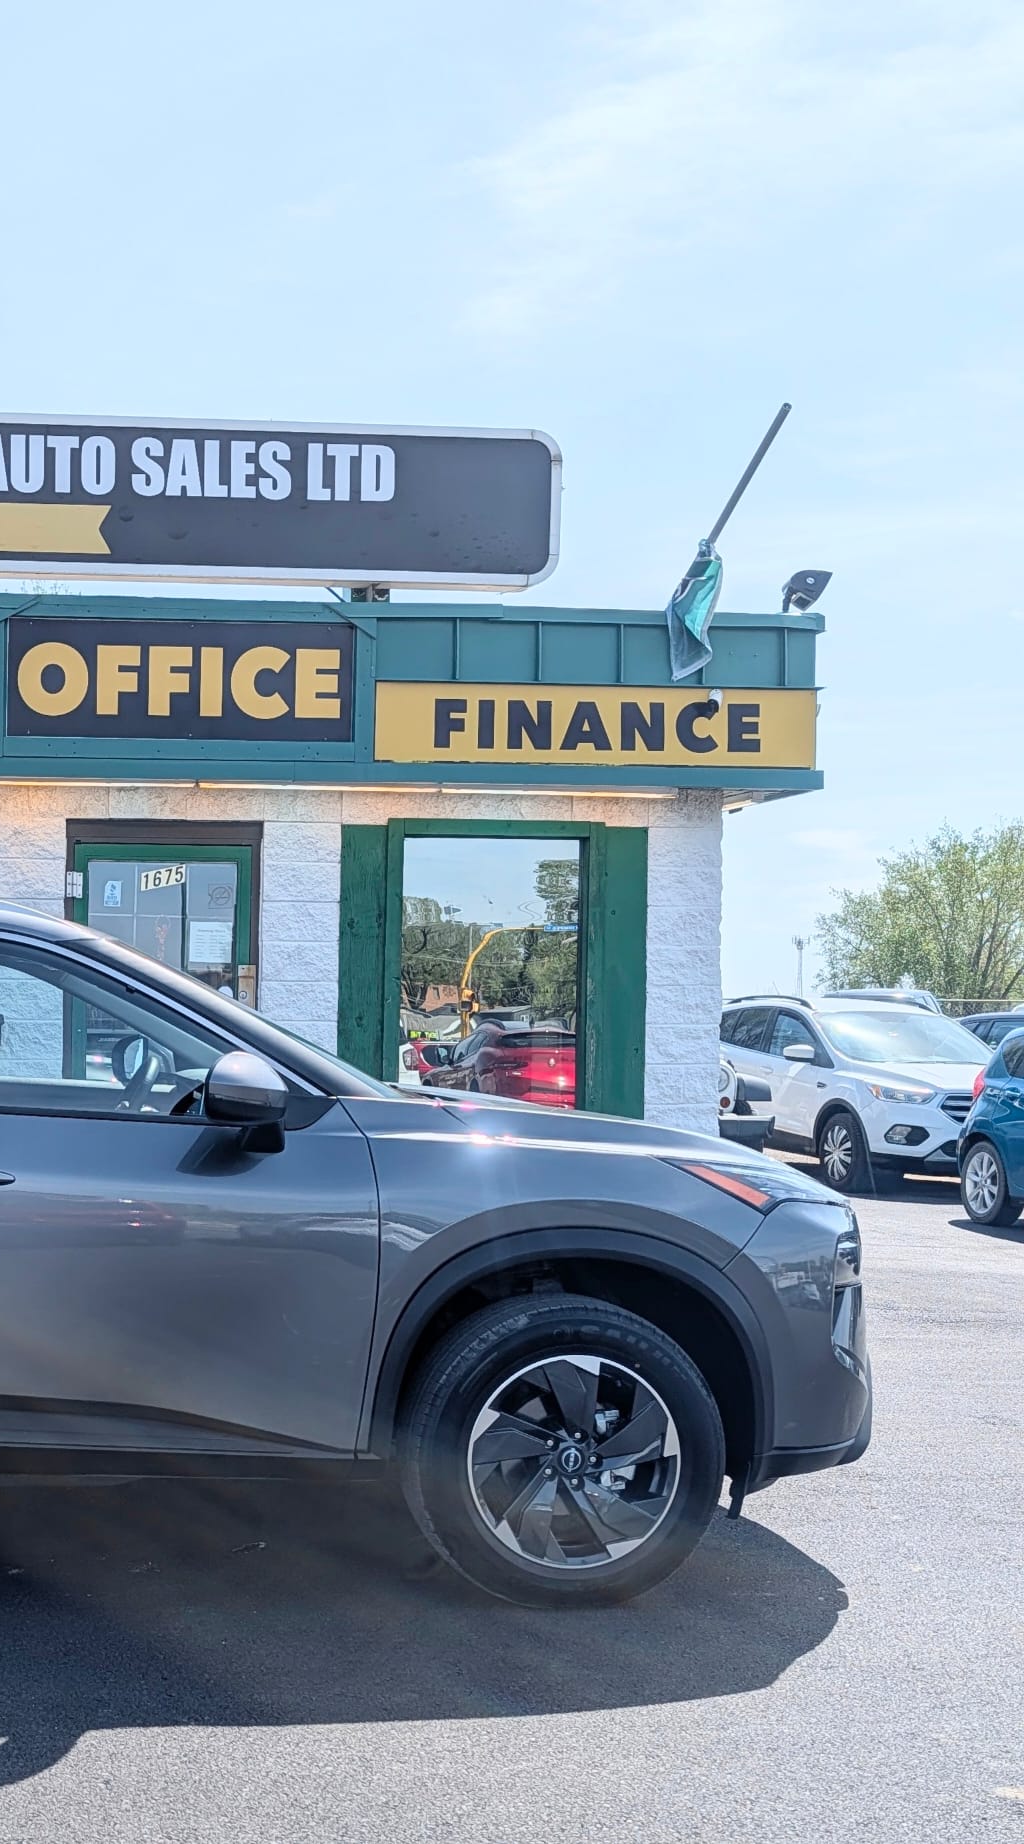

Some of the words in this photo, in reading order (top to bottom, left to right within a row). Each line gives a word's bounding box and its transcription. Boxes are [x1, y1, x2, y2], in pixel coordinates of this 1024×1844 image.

[130, 436, 293, 502] SALES
[306, 442, 396, 504] LTD
[16, 640, 343, 721] OFFICE
[432, 697, 762, 755] FINANCE
[143, 865, 184, 890] 1675
